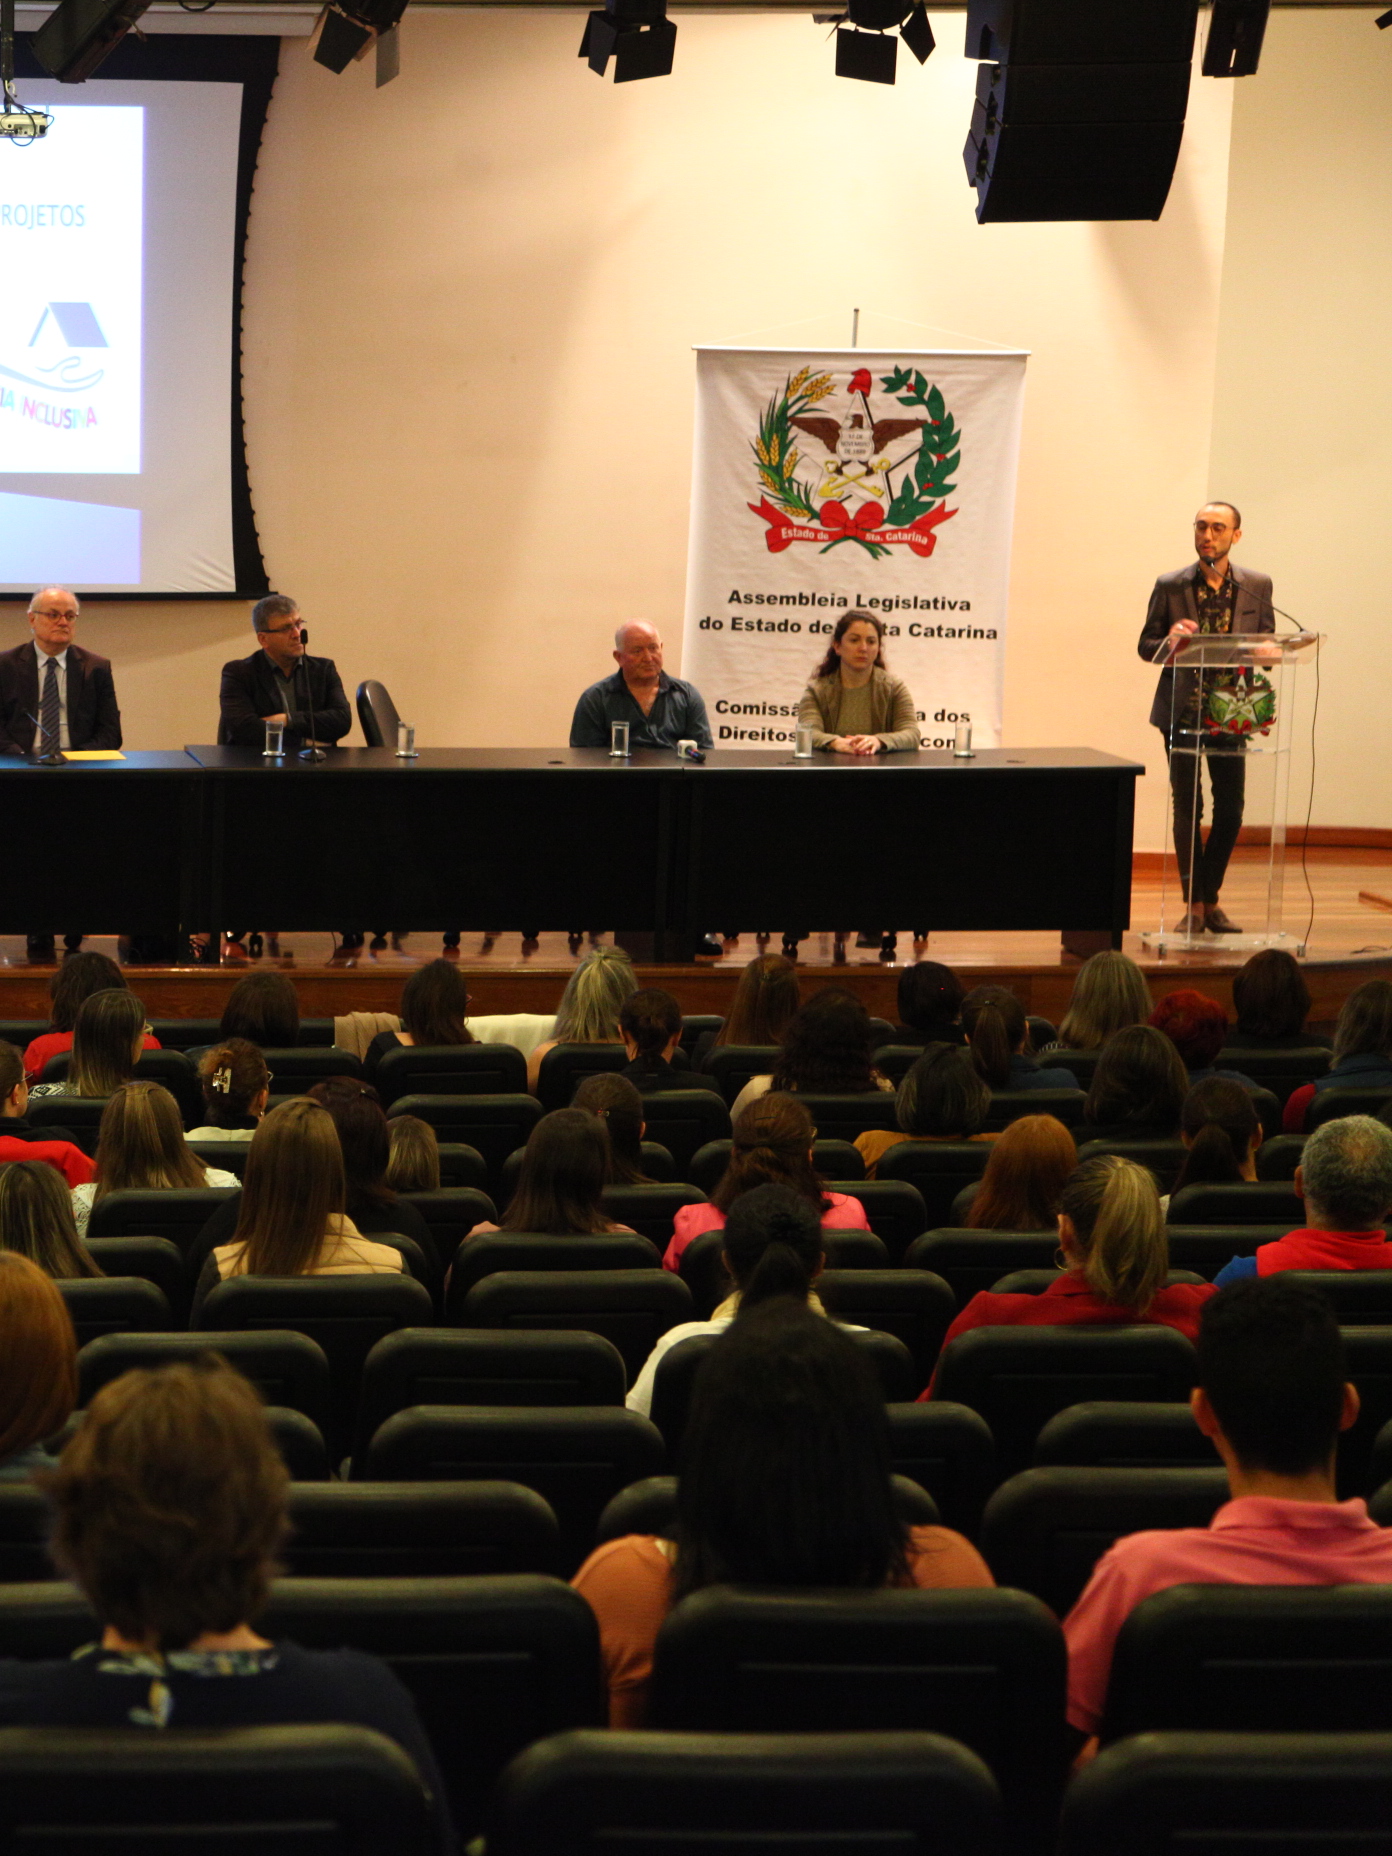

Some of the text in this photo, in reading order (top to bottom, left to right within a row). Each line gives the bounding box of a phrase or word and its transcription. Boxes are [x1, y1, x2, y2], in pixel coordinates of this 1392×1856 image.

[780, 526, 929, 545] Estado de Sta. Catarina
[727, 589, 971, 613] Assembleia Legislativa
[698, 616, 724, 631] do
[730, 616, 802, 634] Estado
[808, 619, 834, 635] de
[908, 622, 998, 640] Catarina
[715, 699, 800, 717] Comissã
[933, 708, 971, 723] dos
[718, 725, 797, 743] Direitos
